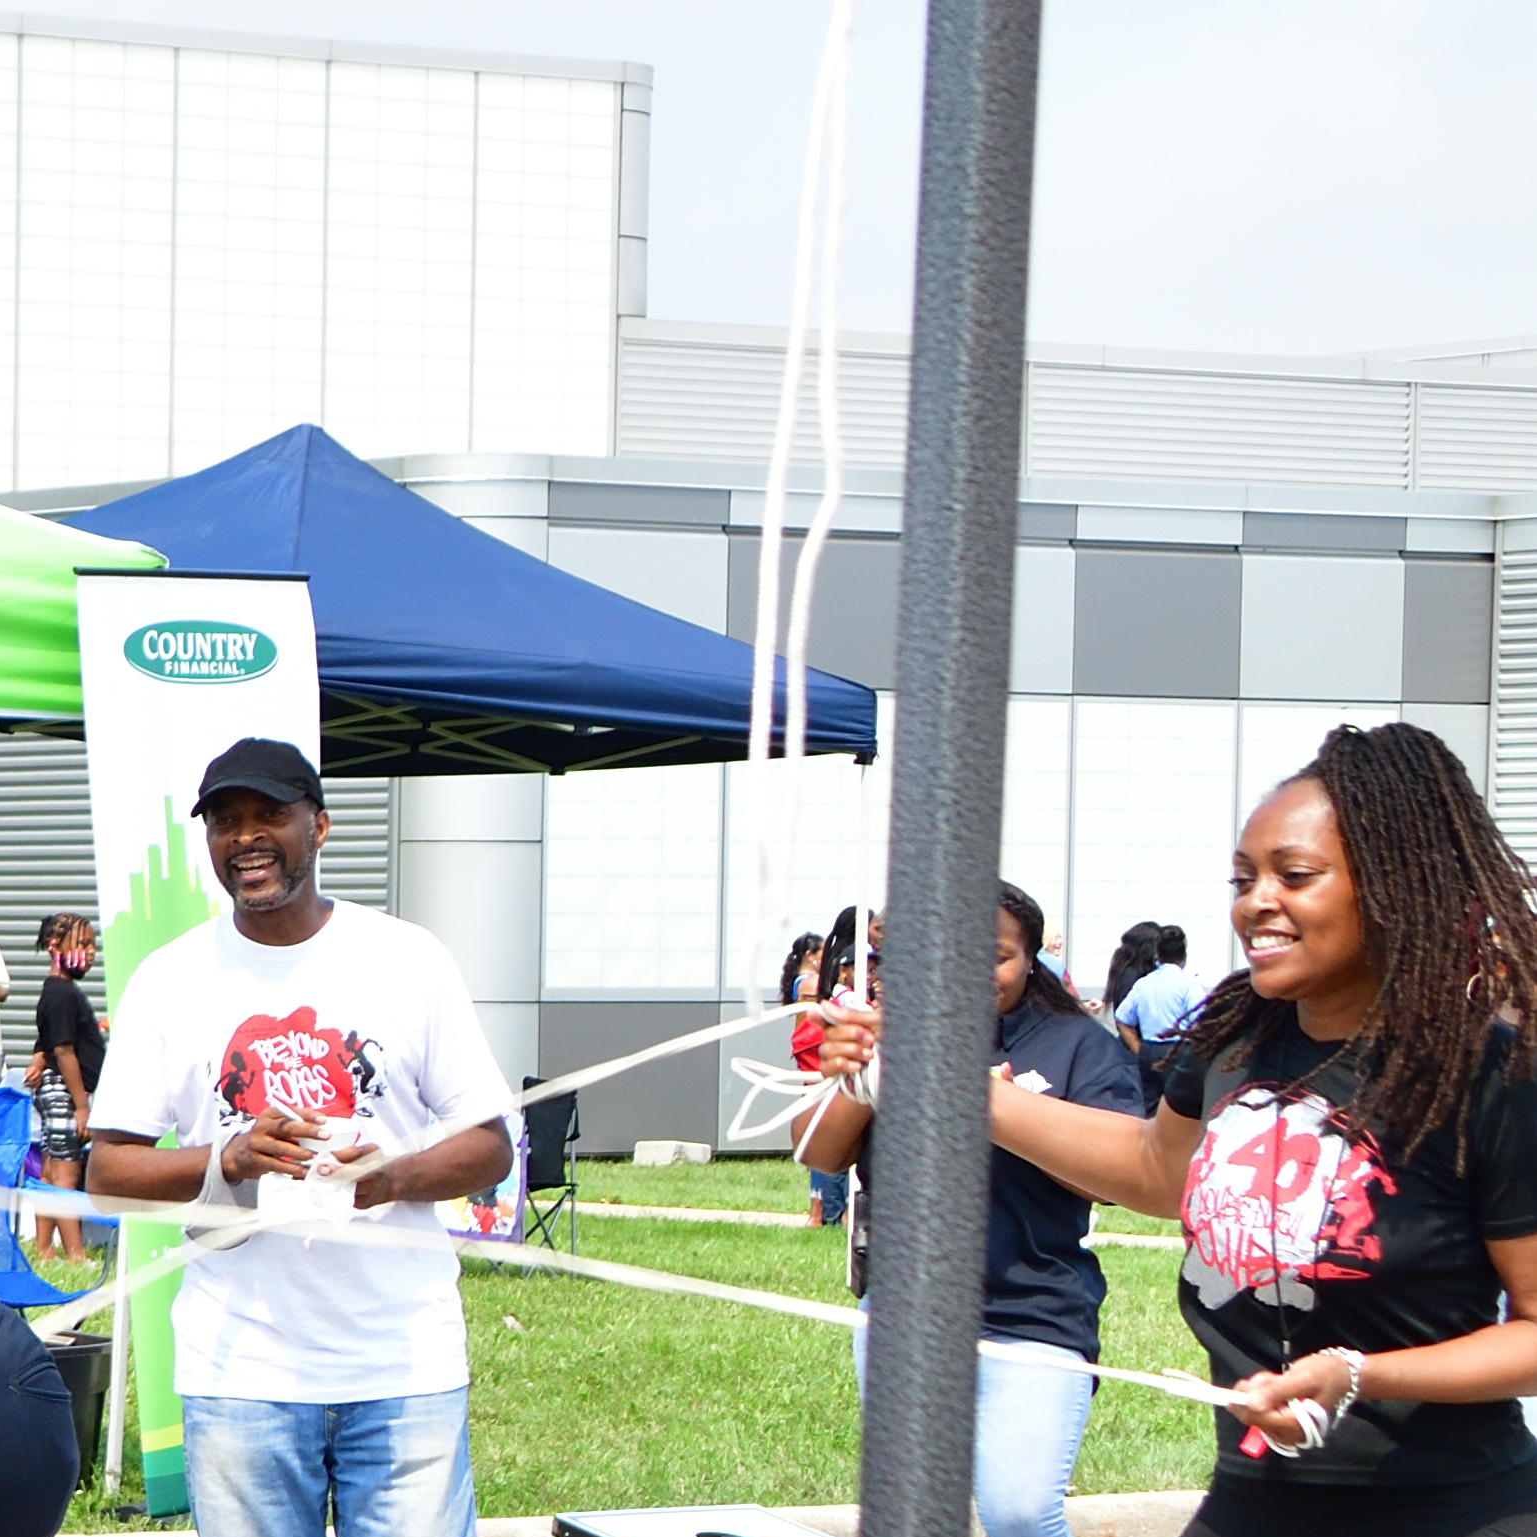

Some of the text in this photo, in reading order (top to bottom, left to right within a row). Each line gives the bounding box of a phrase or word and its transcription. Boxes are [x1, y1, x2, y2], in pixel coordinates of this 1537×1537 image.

[142, 629, 258, 661] COUNTRY
[164, 661, 241, 675] FINANCIAL
[248, 1029, 330, 1069] BEYOND
